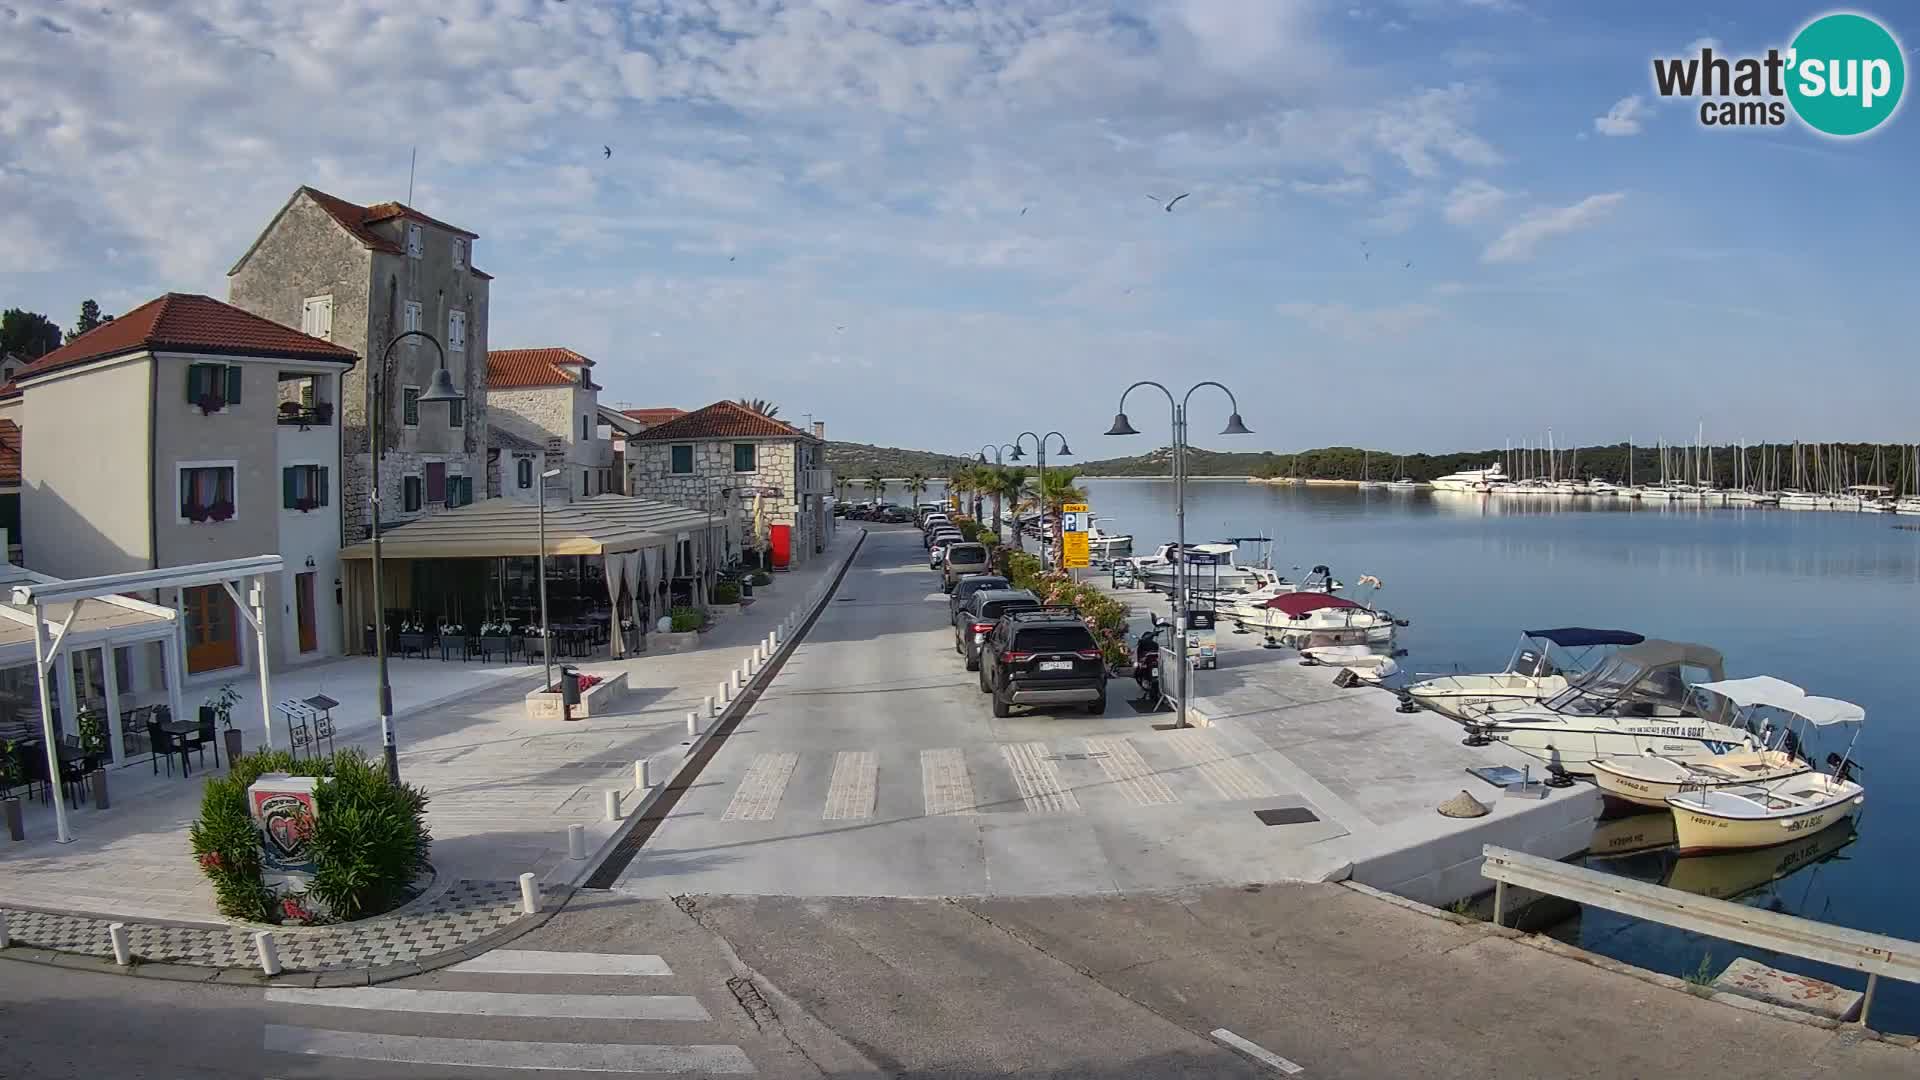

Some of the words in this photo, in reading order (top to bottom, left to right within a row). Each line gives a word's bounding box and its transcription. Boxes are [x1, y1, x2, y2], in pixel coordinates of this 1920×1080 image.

[1661, 727, 1680, 736] RENT
[1681, 728, 1687, 737] A
[1687, 728, 1705, 737] BOAT
